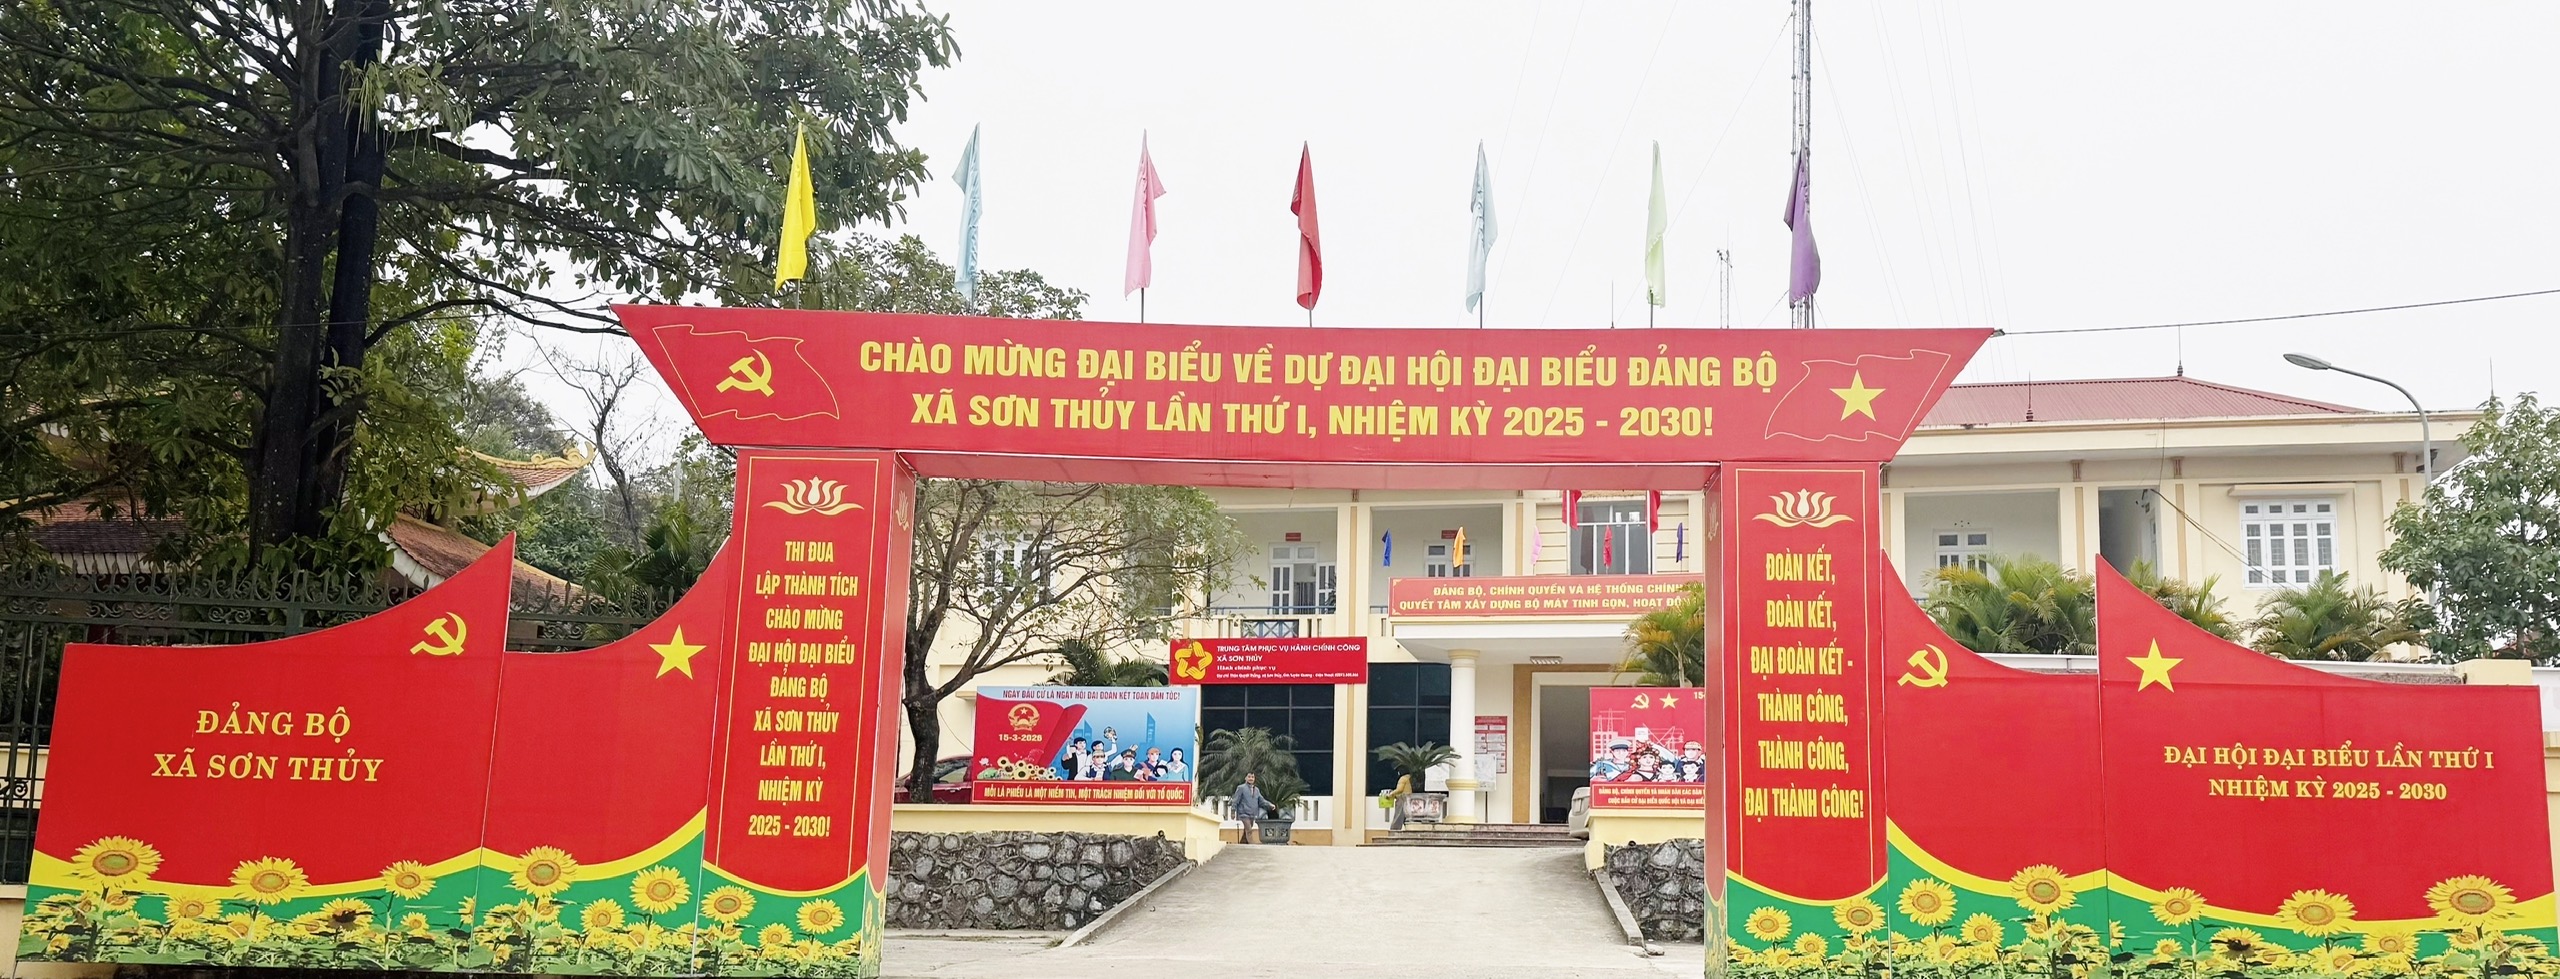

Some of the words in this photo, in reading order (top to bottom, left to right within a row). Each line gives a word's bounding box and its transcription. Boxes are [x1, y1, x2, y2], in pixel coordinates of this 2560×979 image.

[859, 336, 951, 374] CHÀO
[963, 339, 1066, 378] MỪNG
[1077, 348, 1134, 388] ĐẠI
[1147, 339, 1222, 384] BIỂU
[1234, 343, 1274, 385] VỀ
[1285, 350, 1334, 393] DỰ
[1339, 355, 1395, 393] ĐẠI
[1406, 350, 1462, 395] HỘI
[1473, 355, 1529, 395] ĐẠI
[1541, 344, 1616, 387] BIỂU
[1627, 344, 1721, 388] ĐẢNG
[1733, 350, 1777, 396] BỘ
[911, 389, 959, 425] XÃ
[969, 392, 1038, 429] SƠN
[1051, 384, 1135, 430] THỦY
[1147, 391, 1212, 433] LẦN
[1223, 394, 1291, 434] THỨ
[1297, 404, 1317, 439] I,
[1328, 399, 1442, 443] NHIỆM
[1451, 397, 1493, 437] KỲ
[1504, 405, 1585, 437] 2025
[1620, 405, 1715, 437] 2030!
[784, 540, 805, 562] THI
[808, 541, 834, 563] ĐUA
[1765, 547, 1804, 582] ĐOÀN
[1806, 543, 1836, 585] KẾT,
[755, 570, 781, 600] LẬP
[784, 572, 826, 596] THÀNH
[830, 571, 859, 597] TÍCH
[1433, 584, 1465, 596] ĐẢNG
[1467, 585, 1487, 597] BỘ,
[1489, 584, 1525, 596] CHÍNH
[1527, 583, 1566, 596] QUYỀN
[1568, 583, 1584, 595] VÀ
[1587, 583, 1603, 596] HỆ
[1605, 581, 1643, 595] THỐNG
[765, 604, 801, 629] CHÀO
[803, 604, 843, 630] MỪNG
[1399, 597, 1434, 612] QUYẾT
[1436, 598, 1462, 610] TÂM
[1464, 598, 1487, 610] XÂY
[1489, 598, 1522, 611] DỰNG
[1524, 598, 1541, 611] BỘ
[1543, 597, 1569, 609] MÁY
[1571, 598, 1599, 609] TINH
[1601, 597, 1630, 610] GỌN,
[1633, 596, 1664, 610] HOẠT
[1766, 594, 1804, 629] ĐOÀN
[1807, 590, 1837, 633] KẾT,
[748, 642, 771, 667] ĐẠI
[773, 638, 796, 667] HỘI
[799, 643, 822, 669] ĐẠI
[825, 635, 855, 665] BIỂU
[1216, 654, 1228, 662] XÃ
[1228, 654, 1245, 662] SƠN
[1245, 653, 1263, 662] THỦY
[1241, 644, 1257, 652] TÂM
[1258, 645, 1278, 653] PHỤC
[1279, 644, 1289, 653] VỤ
[1290, 644, 1311, 652] HÀNH
[1312, 643, 1336, 652] CHÍNH
[1337, 643, 1361, 652] CÔNG
[1750, 645, 1774, 681] ĐẠI
[1776, 640, 1816, 675] ĐOÀN
[1818, 637, 1843, 676] KẾT
[770, 668, 806, 698] ĐẢNG
[809, 673, 828, 703] BỘ
[195, 701, 294, 736] ĐẢNG
[303, 706, 352, 744] BỘ
[753, 706, 772, 732] XÃ
[775, 708, 803, 732] SƠN
[806, 702, 840, 733] THỦY
[1757, 688, 1803, 723] THÀNH
[1806, 688, 1849, 727] CÔNG,
[151, 746, 198, 778] XÃ
[206, 751, 279, 780] SƠN
[288, 748, 384, 782] THỦY
[760, 737, 787, 767] LẦN
[790, 739, 817, 767] THỨ
[817, 746, 826, 770] I,
[1758, 734, 1804, 770] THÀNH
[1806, 734, 1850, 774] CÔNG,
[2164, 745, 2206, 771] ĐẠI
[2214, 742, 2257, 772] HỘI
[2263, 748, 2307, 772] ĐẠI
[2311, 740, 2369, 768] BIỂU
[2376, 741, 2424, 768] LẦN
[2428, 745, 2479, 769] THỨ
[2485, 751, 2495, 769] I
[757, 775, 803, 806] NHIỆM
[805, 776, 824, 802] KỲ
[1065, 787, 1077, 800] TIN,
[1092, 787, 1113, 800] TRÁCH
[1166, 786, 1185, 800] QUỐC!
[1744, 786, 1768, 823] ĐẠI
[1771, 782, 1817, 818] THÀNH
[1820, 781, 1865, 819] CÔNG!
[2208, 774, 2290, 802] NHIỆM
[2296, 775, 2327, 798] KỲ
[2331, 780, 2381, 800] 2025
[2399, 782, 2447, 801] 2030
[748, 814, 781, 836] 2025
[793, 815, 831, 837] 2030!
